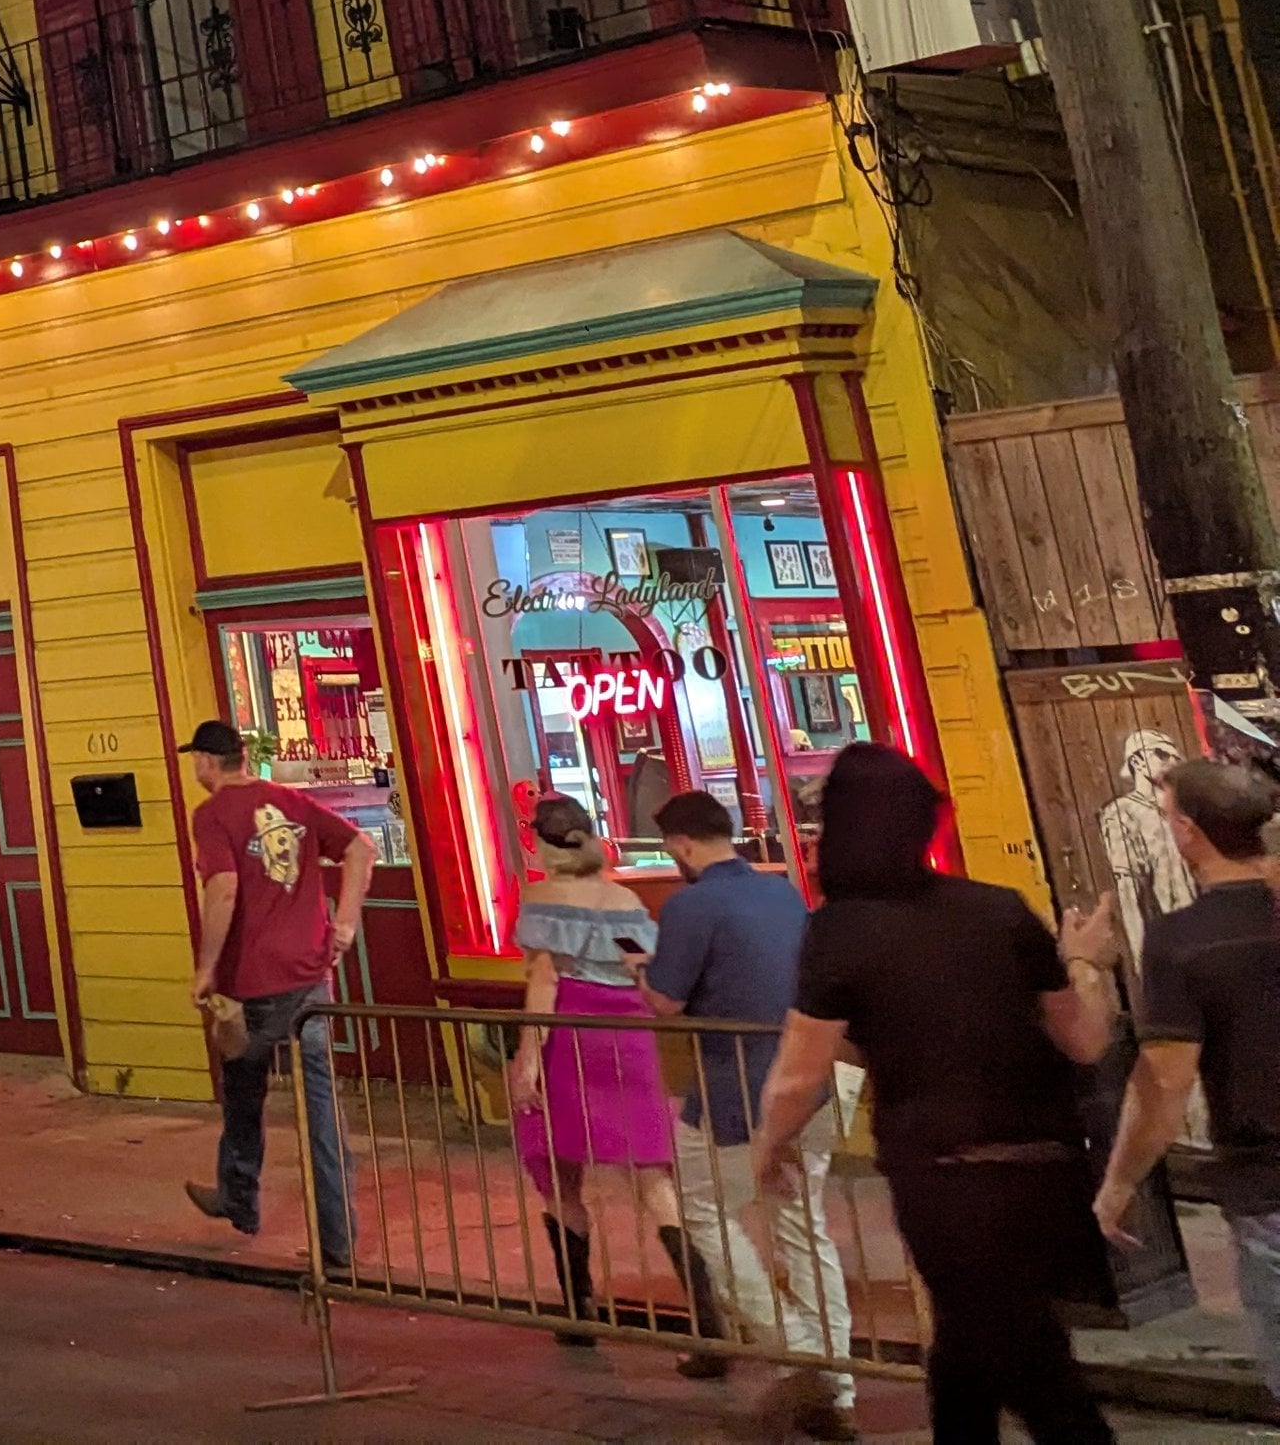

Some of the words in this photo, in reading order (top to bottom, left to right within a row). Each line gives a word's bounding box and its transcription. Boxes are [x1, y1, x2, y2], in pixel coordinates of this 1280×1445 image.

[482, 578, 584, 618] Electric
[588, 566, 717, 617] Ladyland
[501, 645, 728, 692] TATTOO
[568, 669, 664, 720] OPEN
[87, 732, 119, 753] 610
[276, 735, 378, 761] LADYLAND
